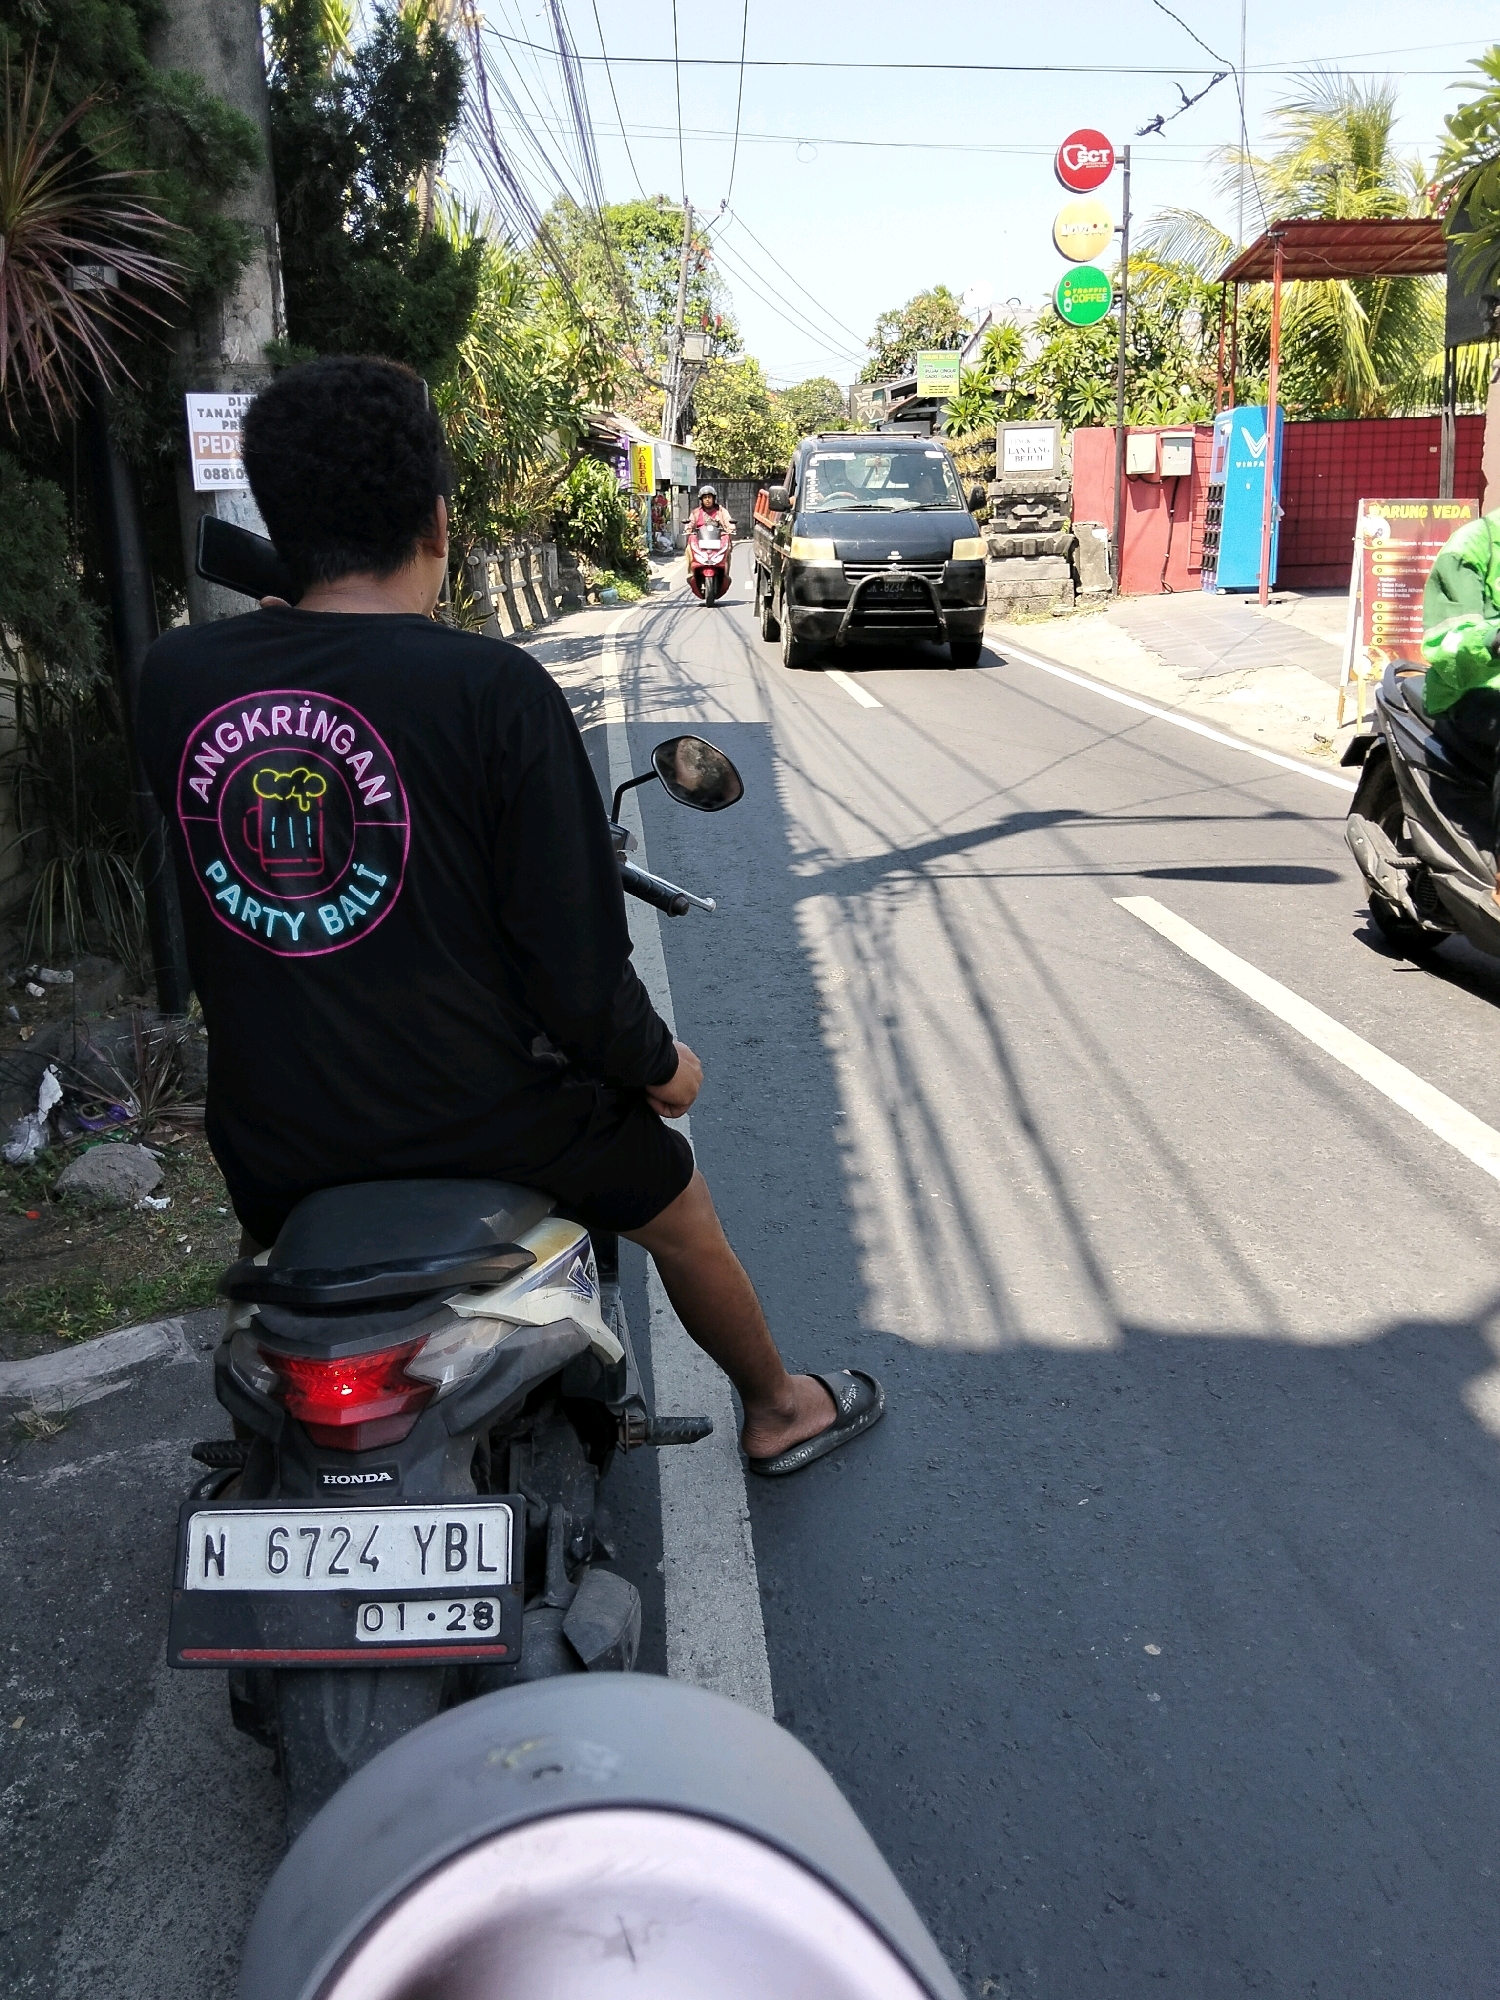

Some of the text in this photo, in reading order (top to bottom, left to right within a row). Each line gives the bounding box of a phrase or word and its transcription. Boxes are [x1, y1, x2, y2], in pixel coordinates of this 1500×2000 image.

[1072, 293, 1108, 304] COFFEE
[228, 396, 250, 407] DIJ
[1008, 446, 1050, 454] LANTANG
[203, 467, 247, 480] 08810
[637, 447, 650, 493] PARFUM
[1433, 504, 1471, 519] VEDA
[205, 860, 305, 941] PARTY
[323, 1472, 393, 1484] HONDA
[204, 1522, 498, 1577] N 6724 YBL
